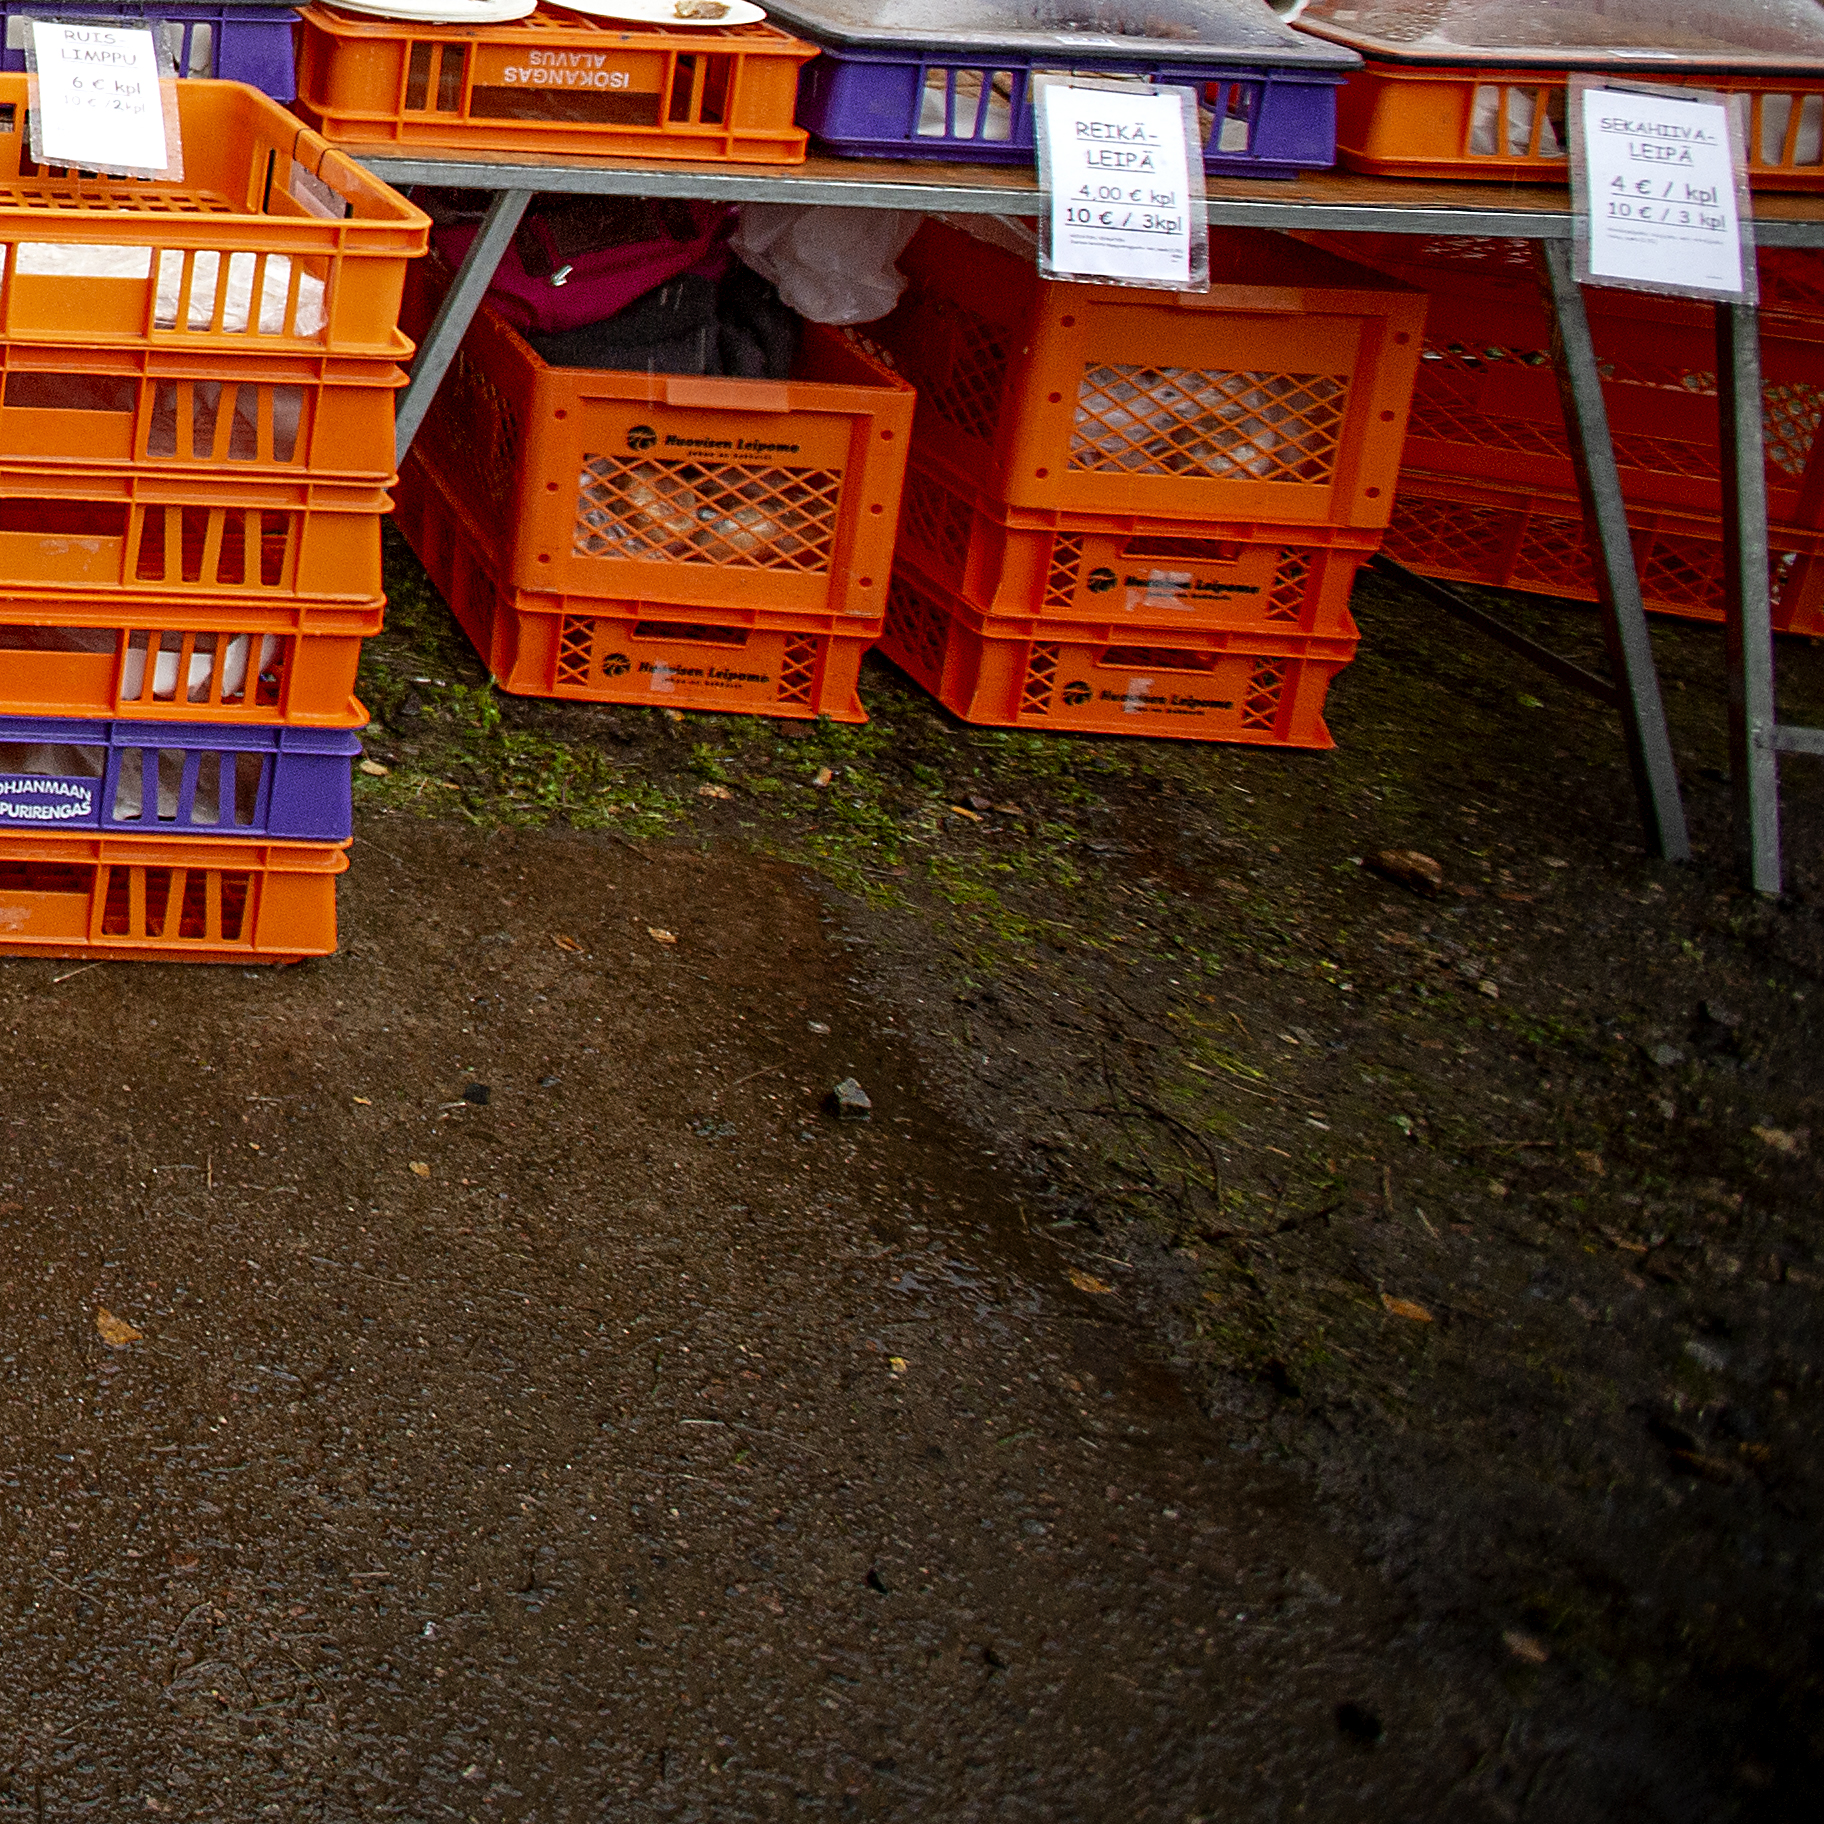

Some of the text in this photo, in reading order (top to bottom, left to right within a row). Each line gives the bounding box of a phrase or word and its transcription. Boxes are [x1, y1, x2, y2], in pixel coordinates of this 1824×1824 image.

[61, 48, 136, 66] LIMPPU
[529, 49, 606, 69] ALAVUS
[72, 76, 140, 96] 6 € kpl
[503, 65, 630, 89] ISOKANGAS
[1086, 149, 1155, 169] LEIPÄ
[1629, 142, 1693, 163] LEIPÄ
[1129, 188, 1141, 201] €
[1150, 189, 1175, 207] kpl
[1610, 175, 1718, 205] 4 € / kpl
[1066, 207, 1091, 223] 10
[1098, 211, 1113, 225] €
[1122, 212, 1132, 227] /
[1608, 201, 1726, 230] 10 € / 3 kpl
[736, 438, 799, 454] Leipomo
[706, 666, 770, 684] Leipomo
